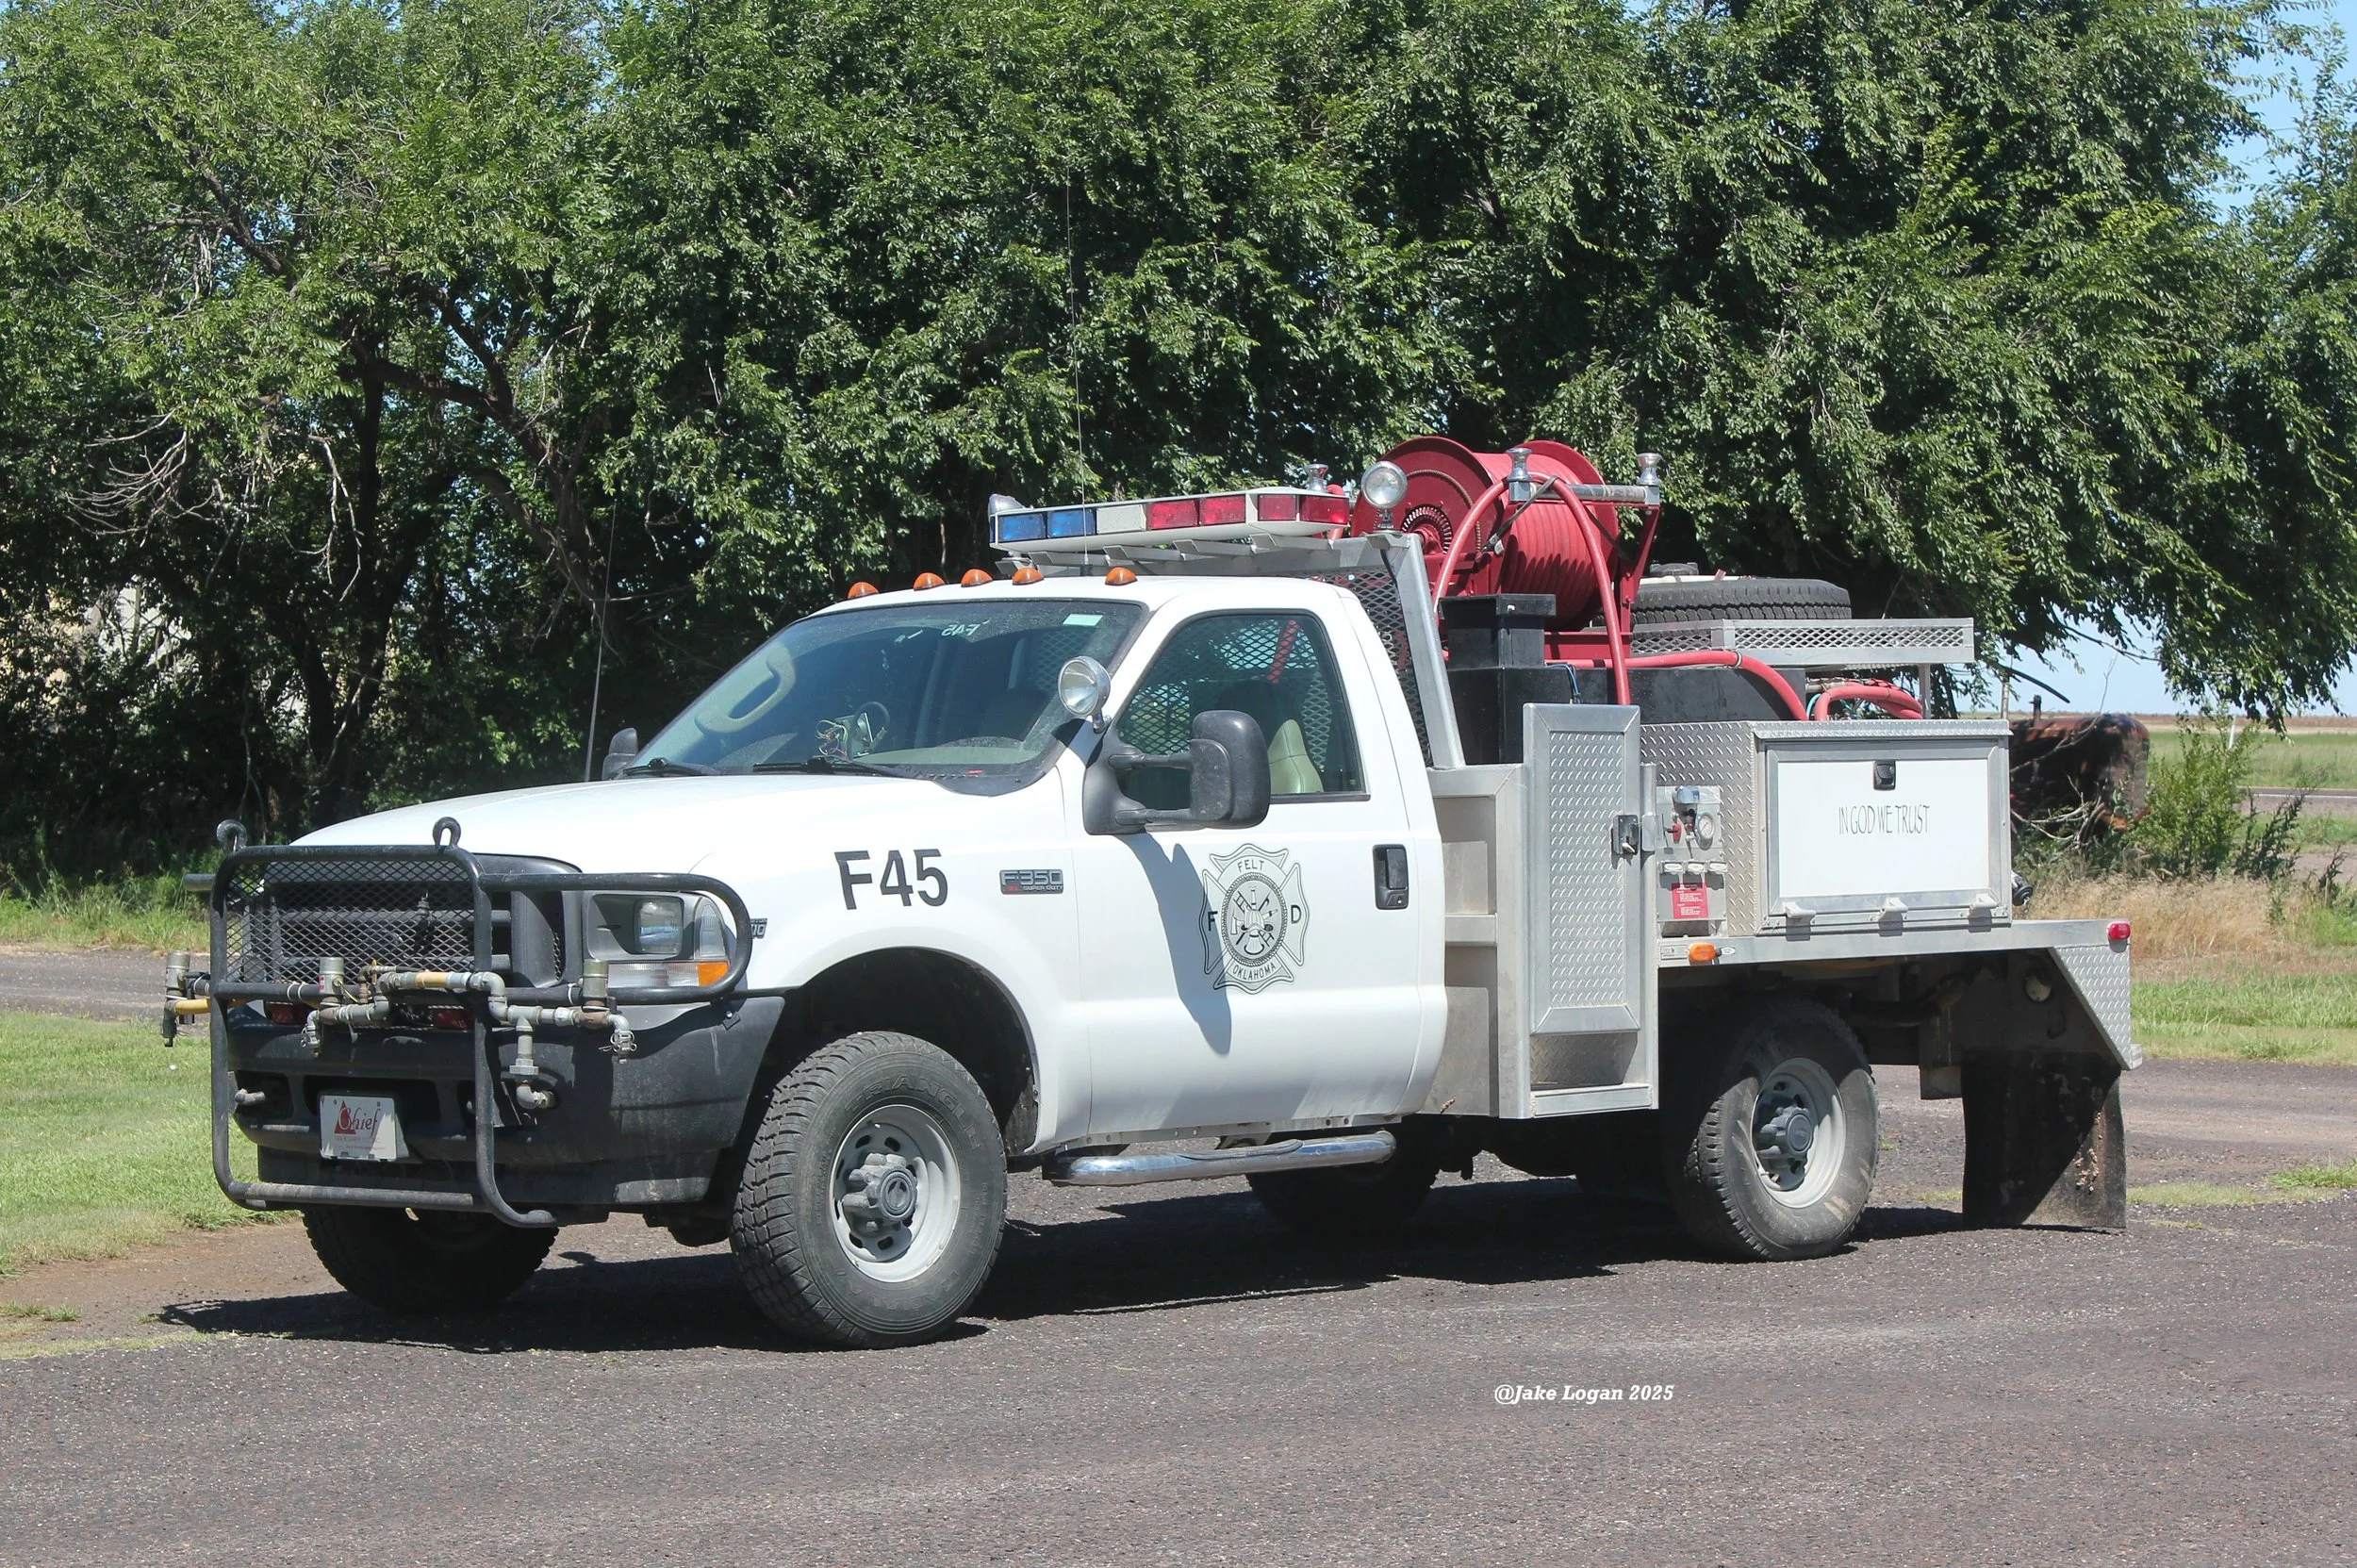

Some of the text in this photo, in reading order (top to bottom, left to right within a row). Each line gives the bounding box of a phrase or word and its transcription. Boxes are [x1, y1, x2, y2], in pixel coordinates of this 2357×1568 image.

[1838, 804, 1930, 834] IN GOD WE TRUST
[834, 849, 948, 910] F45
[1238, 860, 1264, 873] FELT
[1208, 904, 1302, 932] F D
[1232, 963, 1277, 981] OKLAHOMA
[338, 1107, 381, 1138] Chief
